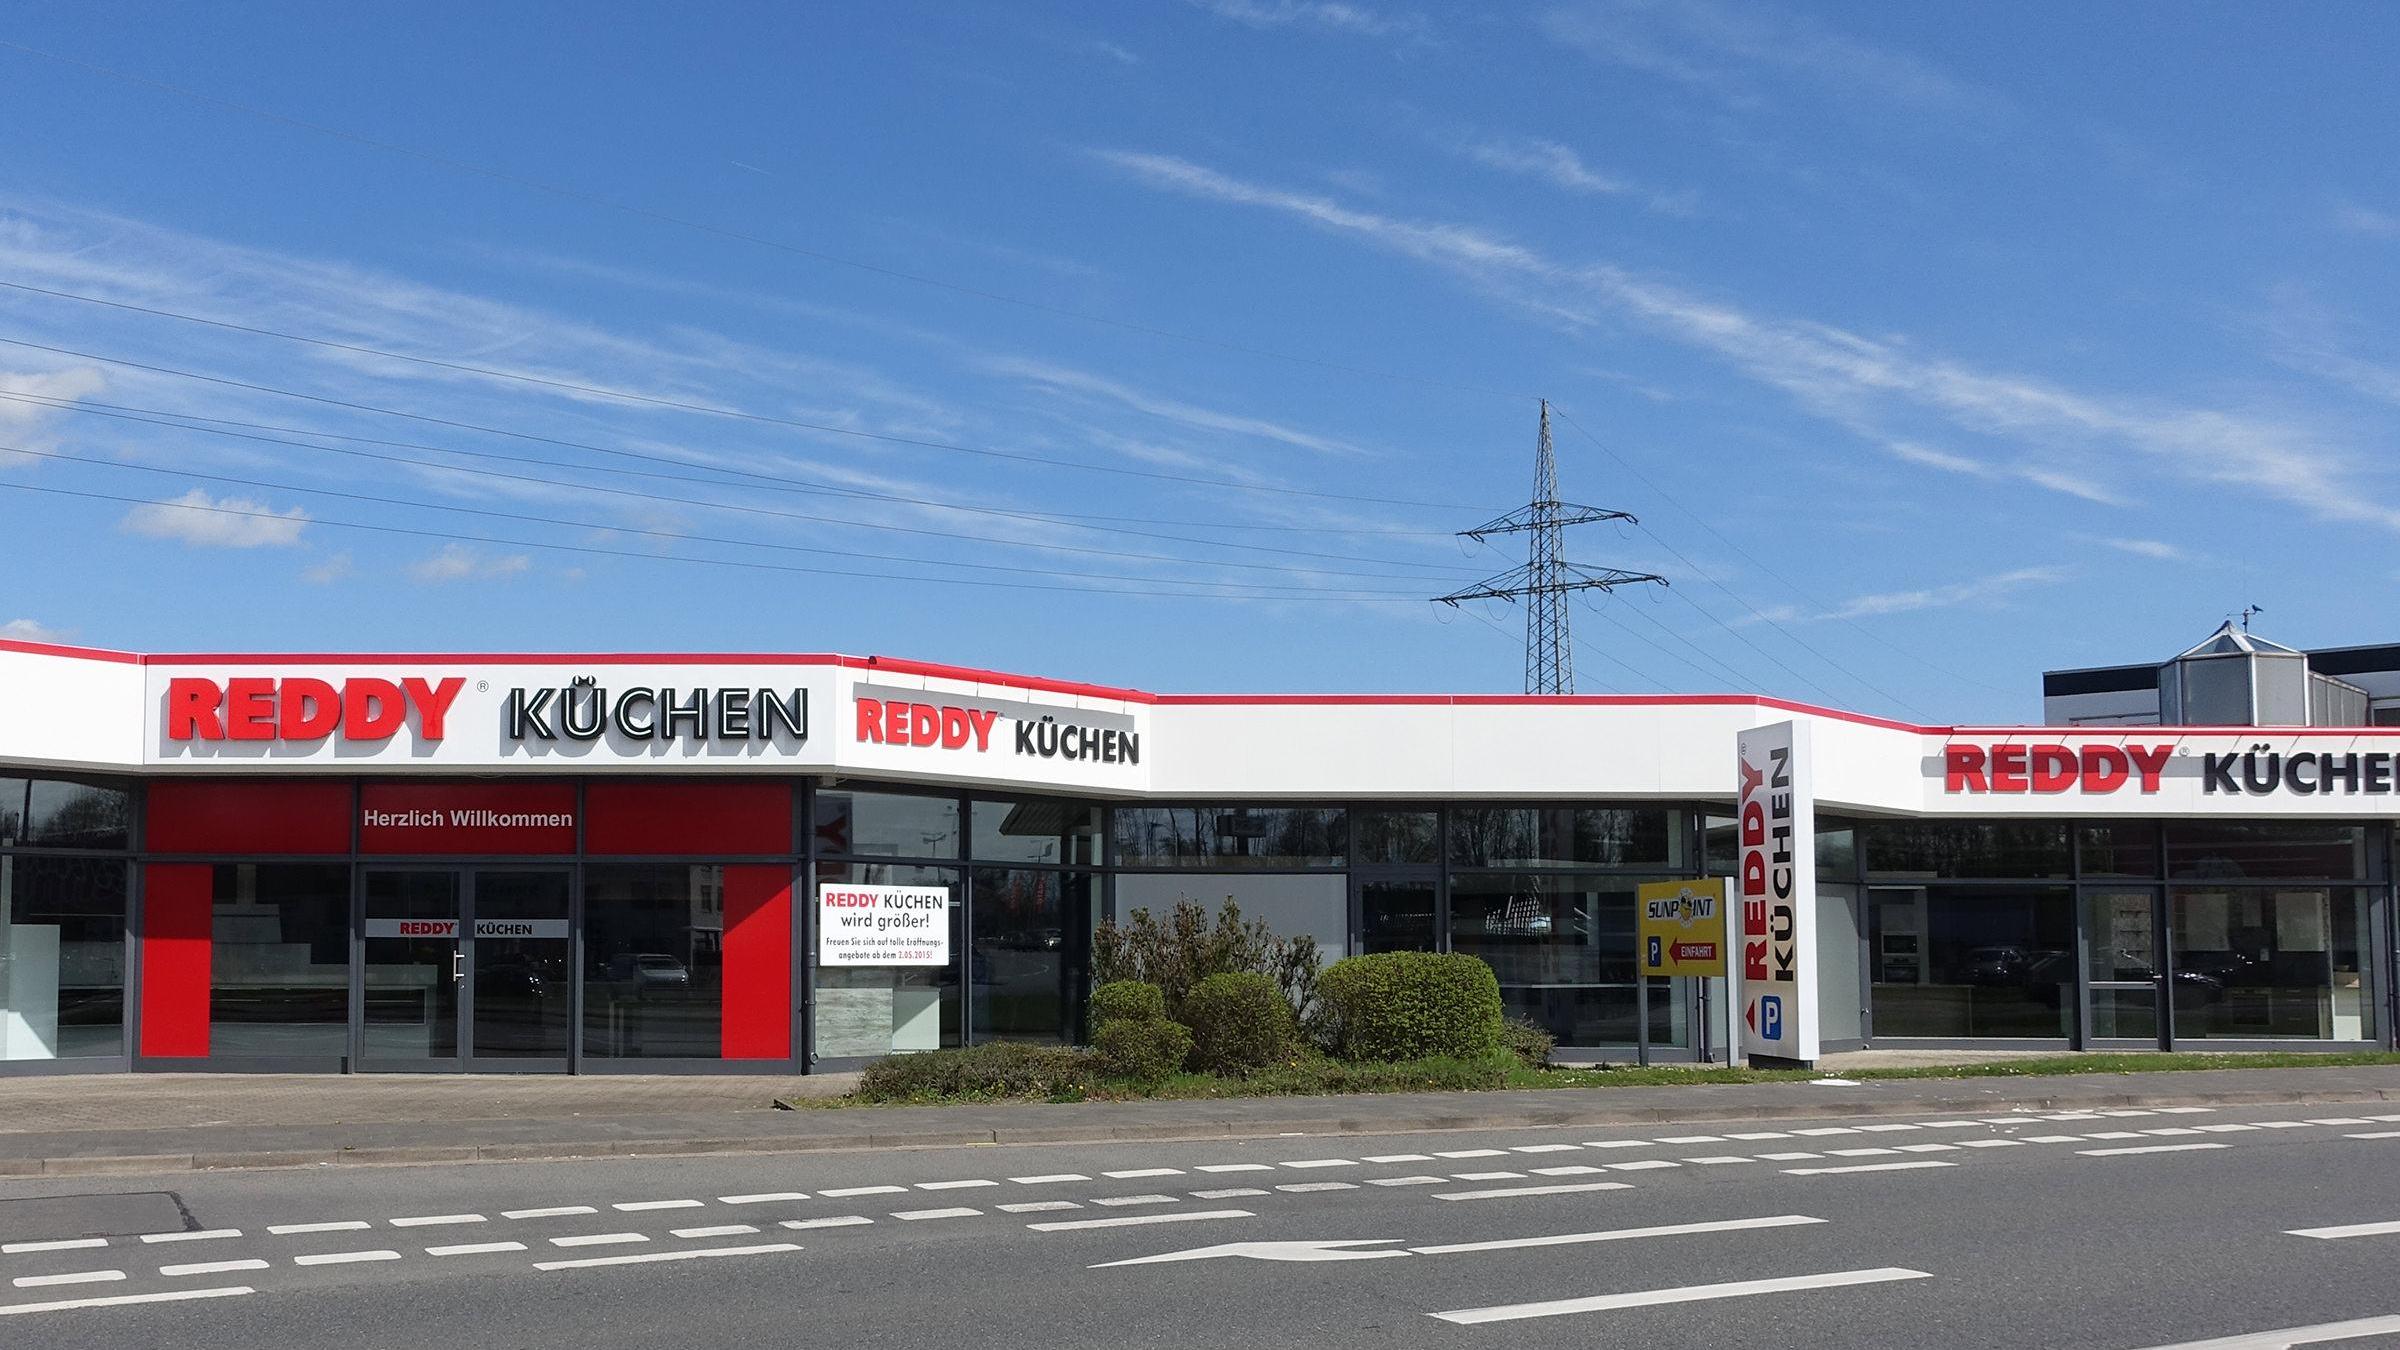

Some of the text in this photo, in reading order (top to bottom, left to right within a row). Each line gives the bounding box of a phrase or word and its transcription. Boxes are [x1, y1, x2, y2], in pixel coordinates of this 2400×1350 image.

[169, 674, 808, 740] REDDY KÜCHEN
[856, 697, 1140, 764] REDDY KÜCHEN
[1945, 743, 2400, 794] REDDY KÜCHE
[364, 810, 573, 827] Herzlich Willkommen
[1741, 756, 1768, 981] REDDY
[1769, 746, 1794, 982] KÜCHEN
[825, 889, 943, 909] REDDY KÜCHEN
[400, 921, 532, 935] REDDY KÜCHEN
[841, 912, 930, 932] wird größer!
[826, 937, 944, 948] Freuen Sie sich auf tolle Eröffnungs-
[1651, 942, 1658, 961] P
[1680, 945, 1712, 957] EINFAHRT
[838, 951, 870, 961] angebote
[872, 951, 881, 959] ab
[882, 951, 897, 959] dem
[1766, 1001, 1780, 1035] P
